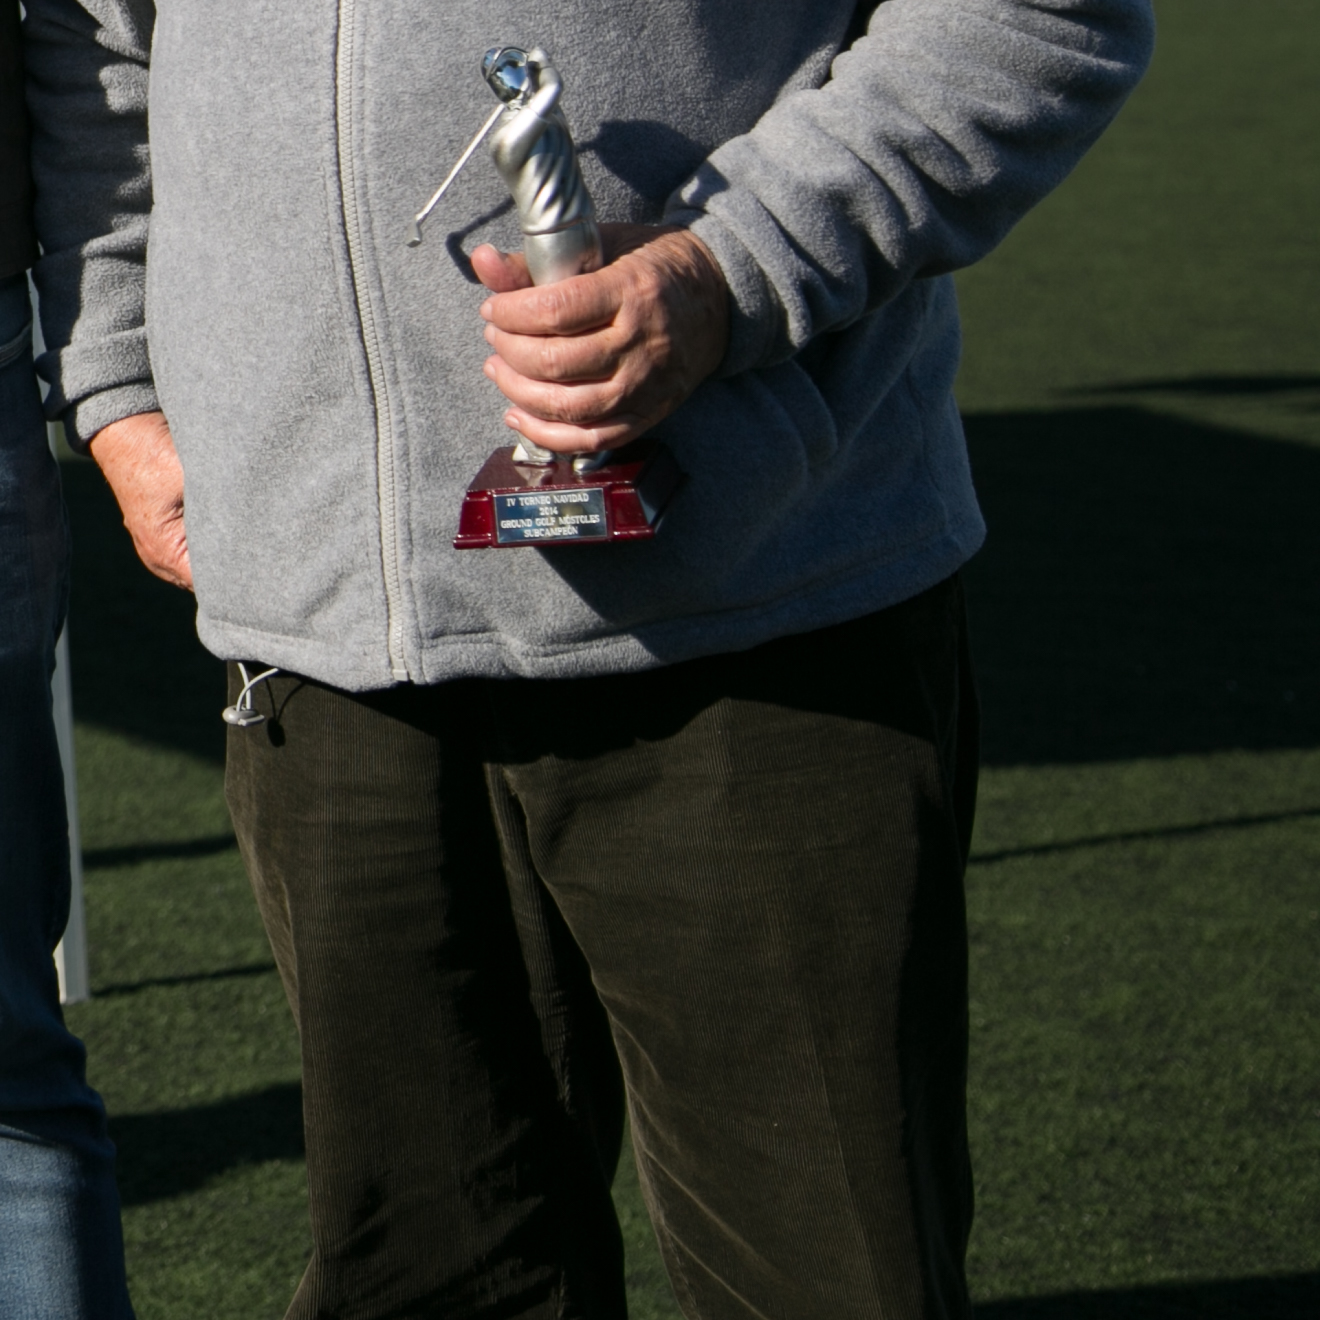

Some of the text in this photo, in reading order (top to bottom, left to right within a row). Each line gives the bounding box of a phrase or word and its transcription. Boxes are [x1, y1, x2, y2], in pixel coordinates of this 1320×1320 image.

[506, 492, 589, 507] IV TORNEO NAVIDAD
[539, 507, 558, 516] 2014
[500, 518, 533, 529] GROUND
[535, 517, 556, 527] GOLF
